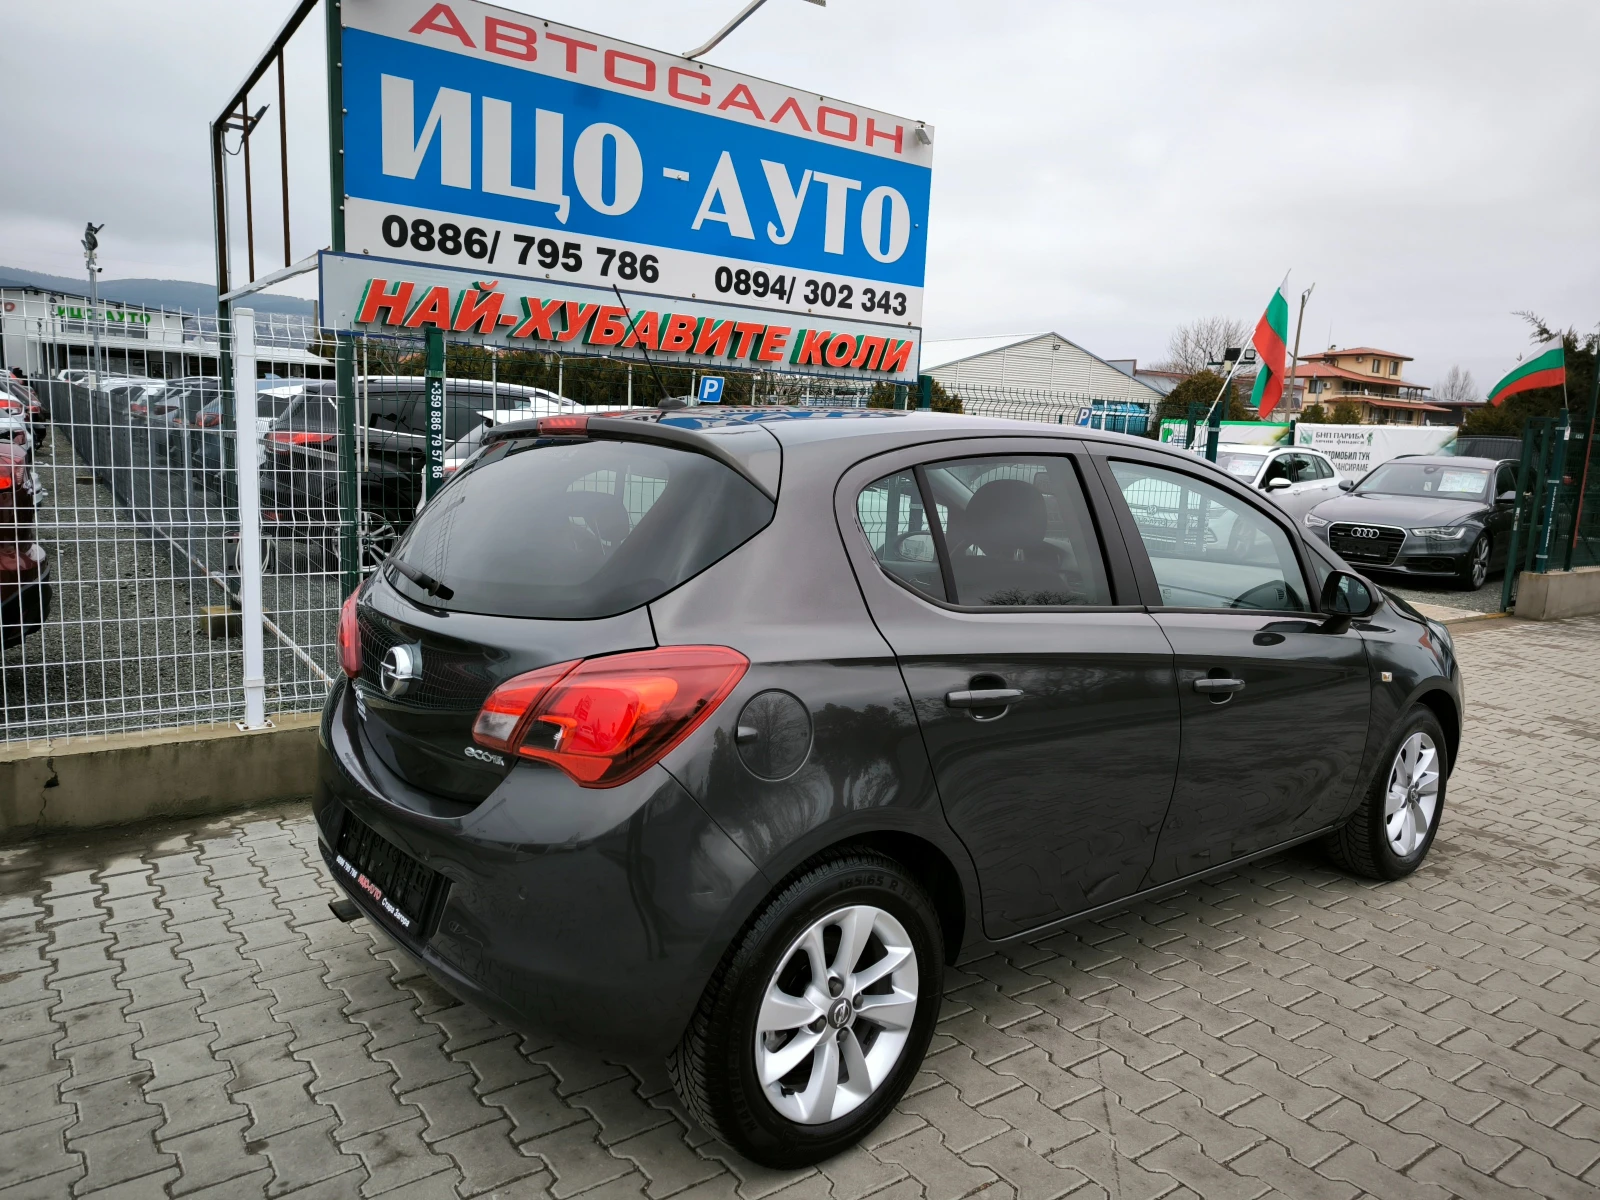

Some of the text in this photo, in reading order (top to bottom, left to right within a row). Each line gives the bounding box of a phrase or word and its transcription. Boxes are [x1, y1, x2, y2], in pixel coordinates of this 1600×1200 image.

[408, 2, 904, 154] АВТОСАЛОН
[381, 214, 660, 284] 0886/ 795 786
[714, 265, 908, 317] 0894/ 302 343
[357, 277, 914, 373] НАЙ-ХУБАВИТЕ КОЛИ
[703, 379, 719, 399] P
[430, 381, 443, 479] +359 886 79 57 86
[1315, 431, 1365, 440] БНП ПАРИБА
[1358, 451, 1371, 461] ТУК
